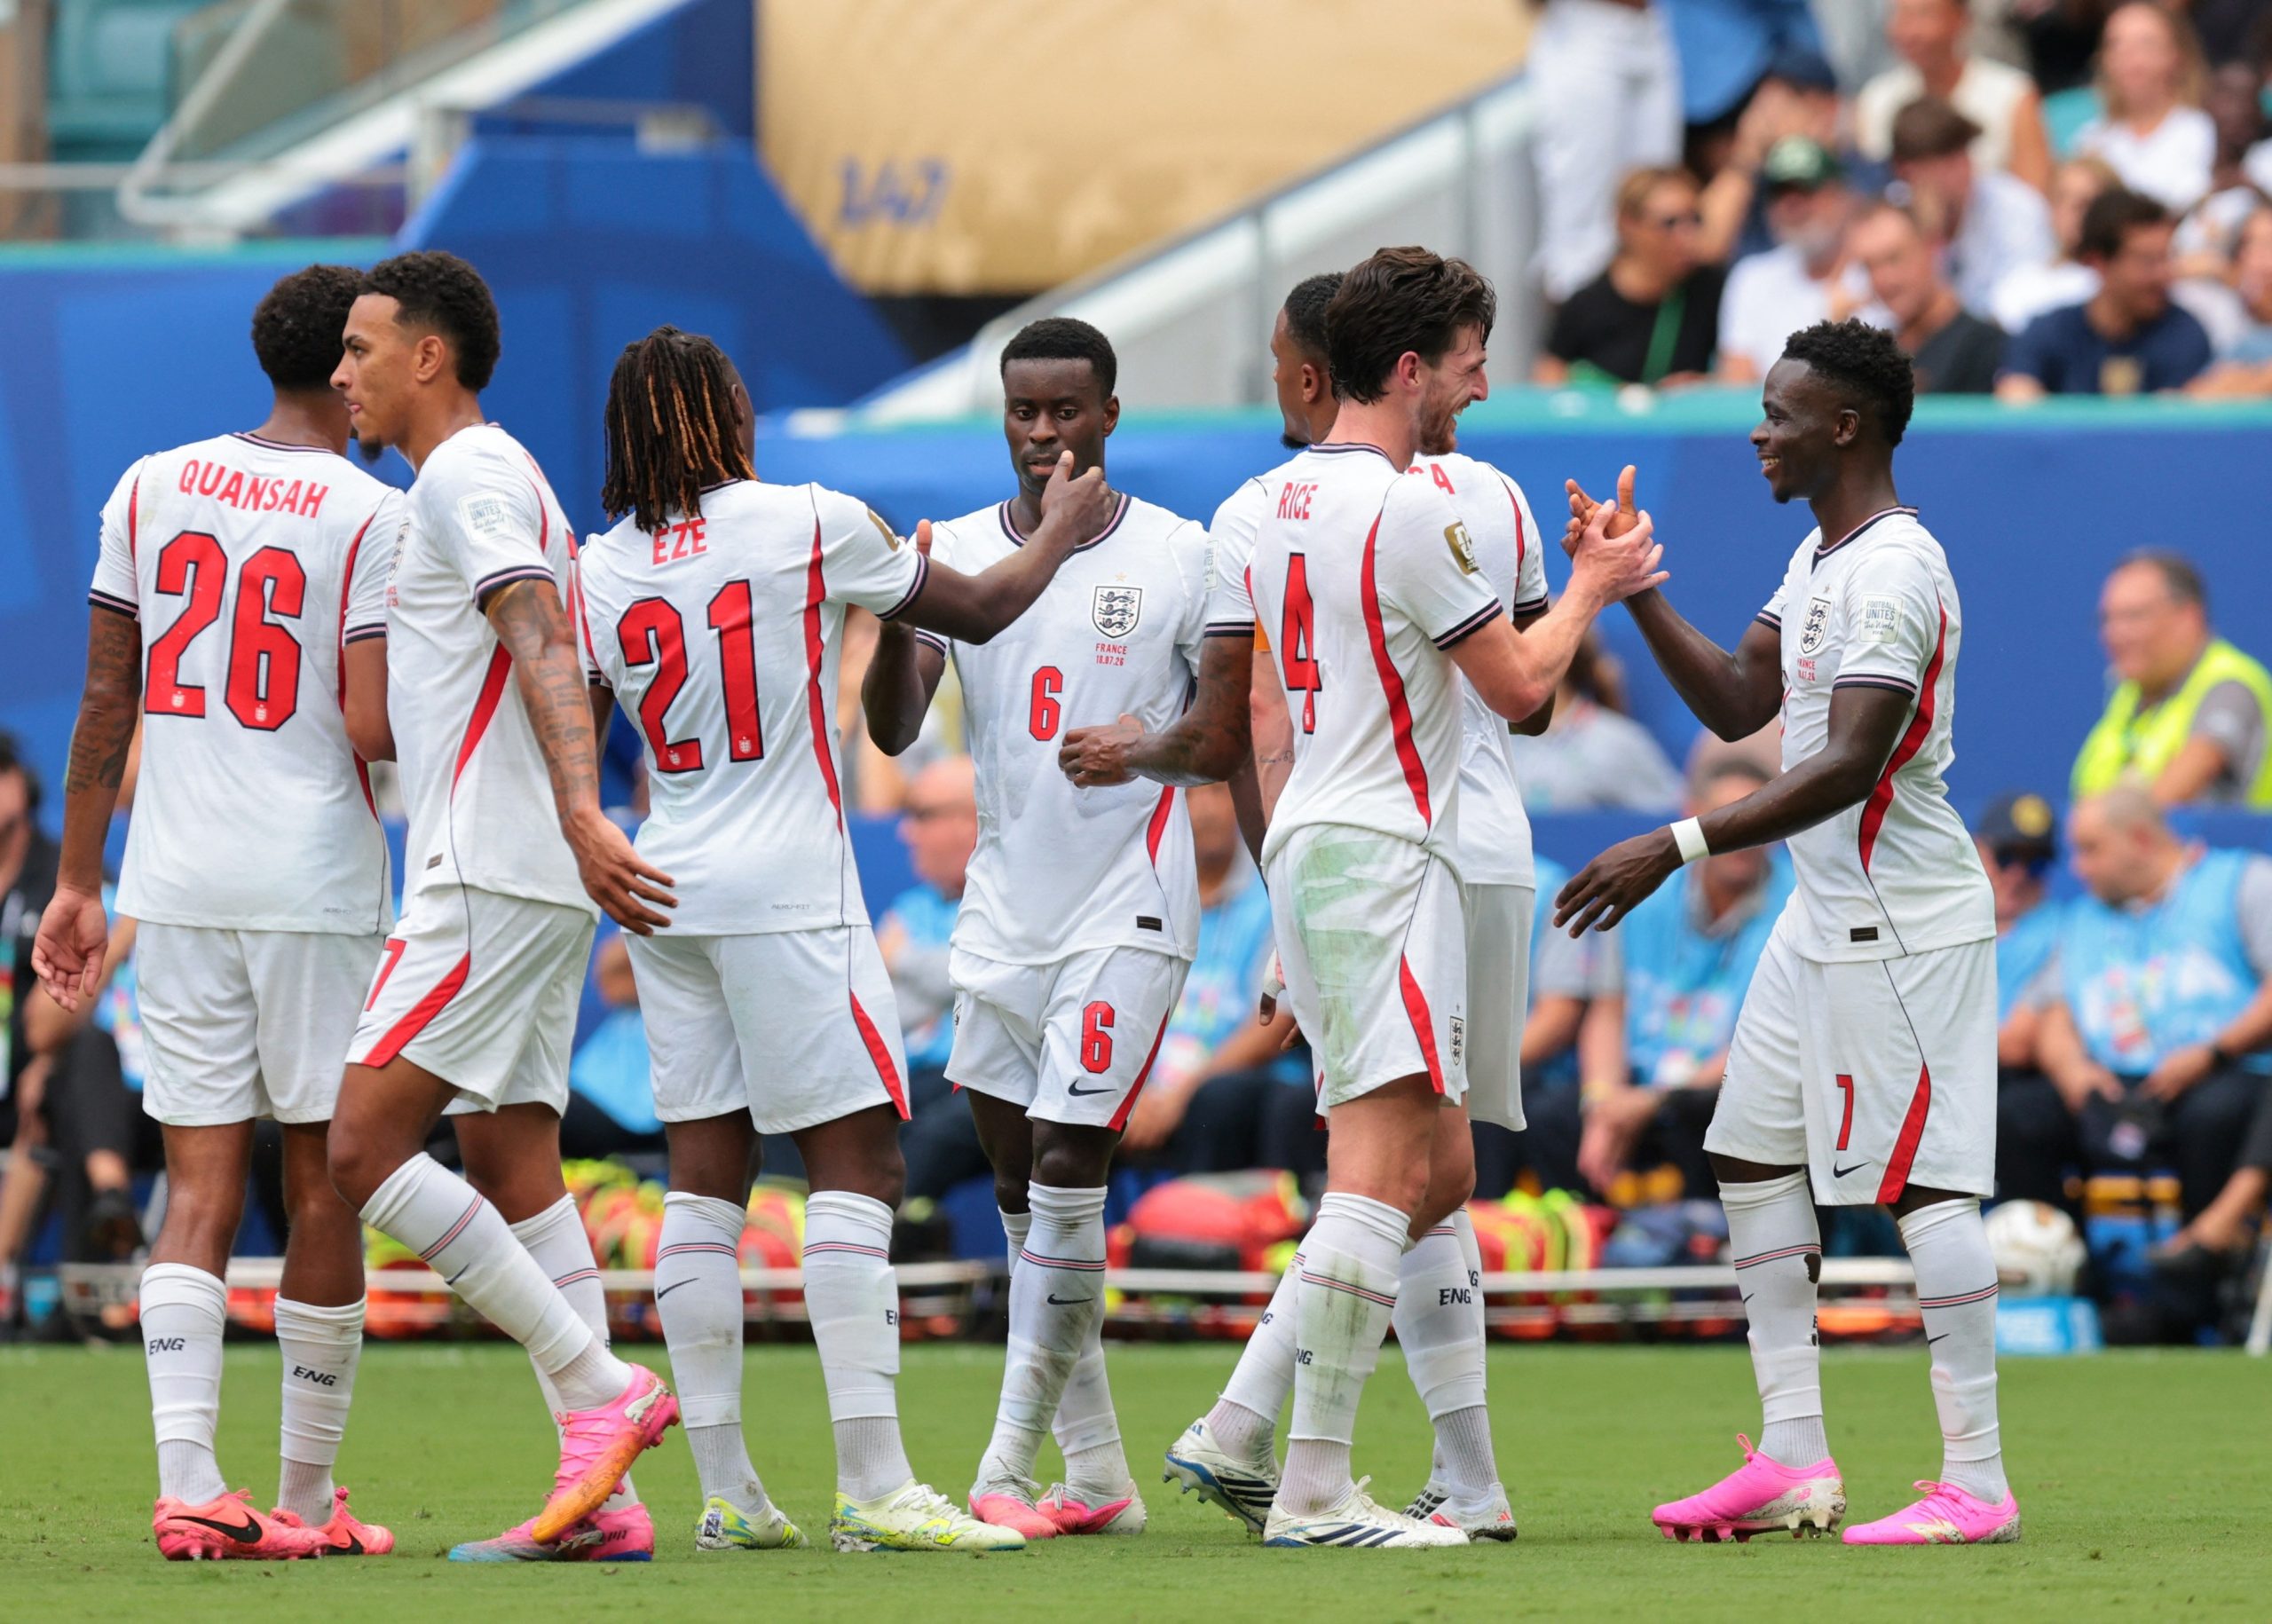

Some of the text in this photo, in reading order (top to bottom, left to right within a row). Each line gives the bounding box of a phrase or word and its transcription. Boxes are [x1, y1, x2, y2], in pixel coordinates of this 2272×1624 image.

[179, 459, 328, 518] QUANSAH
[1277, 482, 1318, 520] RICE
[652, 517, 707, 565] EZE
[145, 530, 306, 732] 26
[1866, 609, 1896, 621] UNITES
[1095, 643, 1127, 655] FRANCE
[1095, 654, 1124, 666] 18.07.26
[1282, 552, 1321, 734] 4
[1797, 658, 1816, 670] FRANCE
[618, 579, 763, 772] 21
[1030, 666, 1062, 741] 6
[1080, 1001, 1116, 1074] 6
[1835, 1075, 1854, 1151] 7
[1440, 1288, 1471, 1305] ENG
[148, 1337, 185, 1356] ENG
[293, 1365, 336, 1387] ENG
